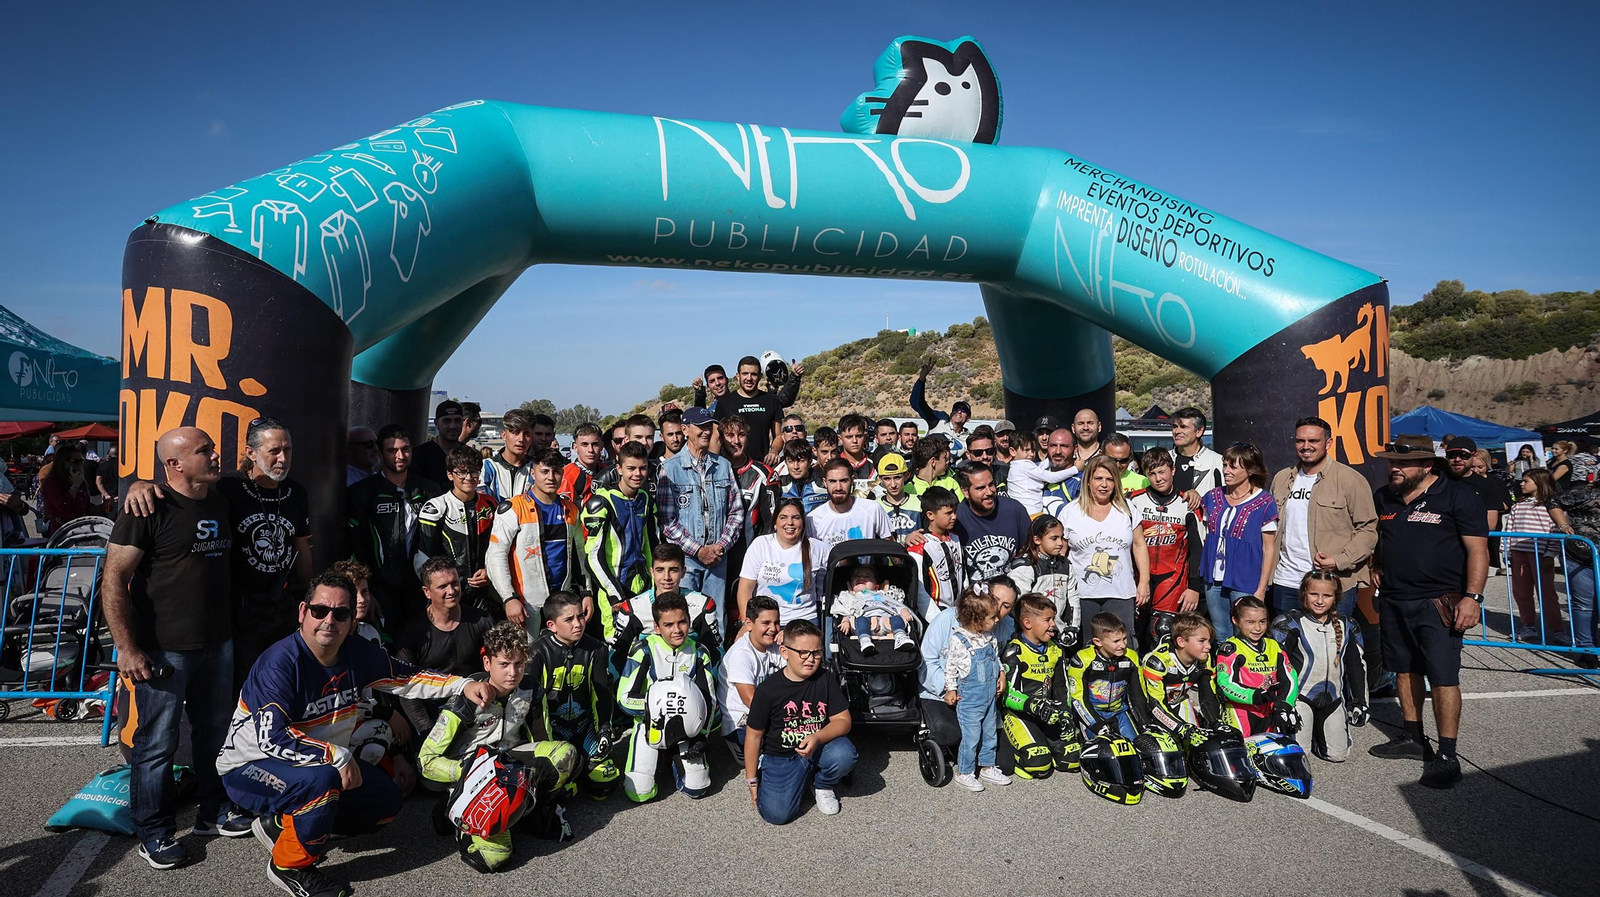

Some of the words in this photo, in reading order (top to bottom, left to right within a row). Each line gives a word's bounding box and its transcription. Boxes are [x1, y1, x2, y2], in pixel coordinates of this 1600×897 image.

[1056, 190, 1113, 234] IMPRENTA
[1064, 158, 1215, 225] MERCHANDISING
[654, 218, 968, 261] PUBLICIDAD
[1087, 182, 1158, 223] EVENTOS
[1163, 214, 1275, 277] DEPORTIVOS
[1117, 217, 1178, 268] DISEÑO
[606, 255, 974, 280] www.nekopublicidad.es
[122, 286, 268, 397] MR.
[20, 388, 72, 402] PUBLICIDAD
[965, 535, 1016, 559] BILLABONG
[666, 692, 677, 715] Bull
[1117, 741, 1130, 753] 10
